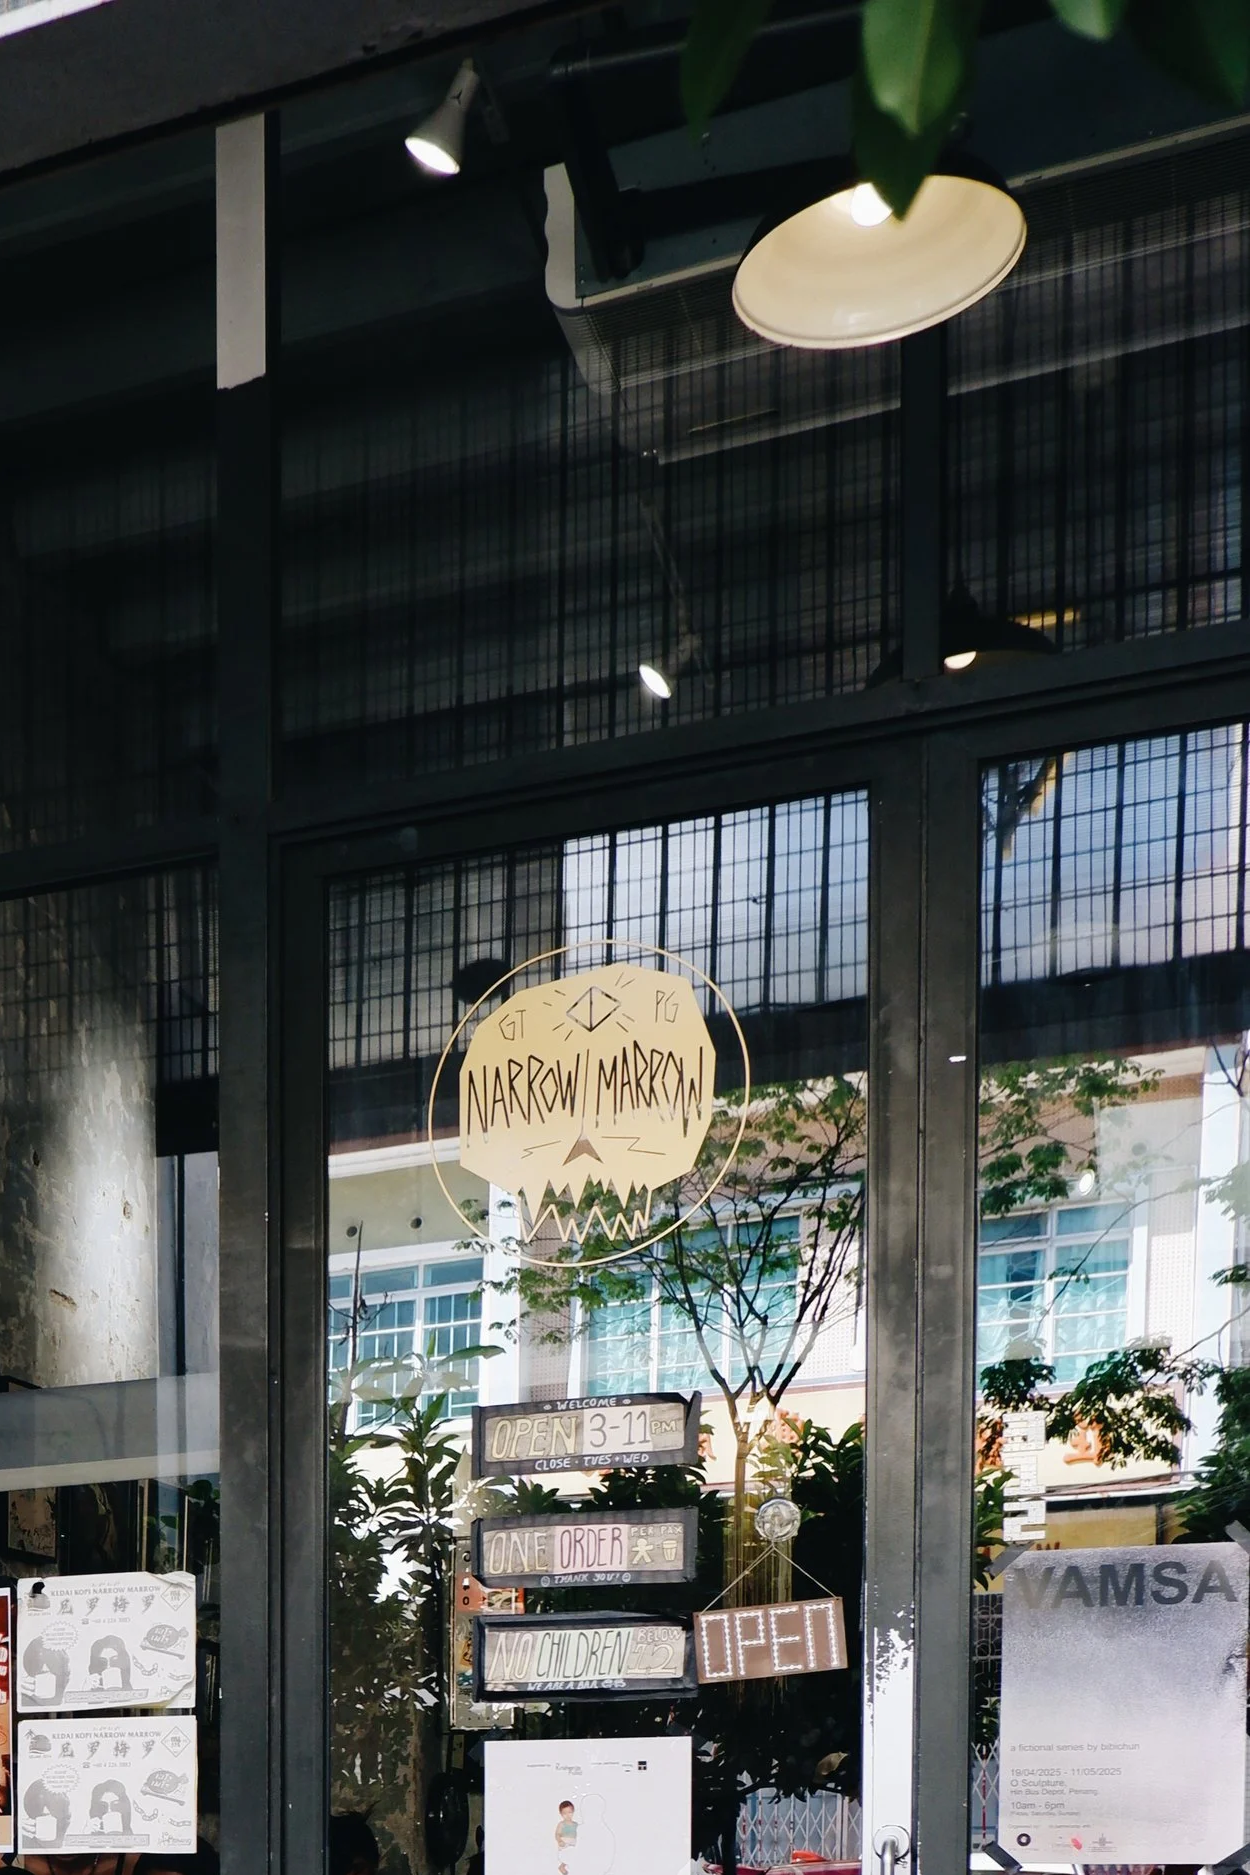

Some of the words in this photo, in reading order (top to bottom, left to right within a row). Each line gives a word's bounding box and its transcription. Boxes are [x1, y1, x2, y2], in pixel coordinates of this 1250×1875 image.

[655, 989, 680, 1024] PG
[498, 1010, 526, 1041] GT
[466, 1053, 580, 1142] NARROW
[596, 1040, 704, 1138] MARROW
[557, 1397, 617, 1410] WELCOME
[490, 1415, 578, 1459] OPEN
[589, 1411, 651, 1448] 3-11
[651, 1420, 677, 1435] PM
[534, 1457, 571, 1471] CLOSE
[583, 1454, 612, 1466] TUES
[623, 1453, 650, 1464] WED
[489, 1531, 549, 1575] ONE
[560, 1527, 623, 1569] ORDER
[631, 1526, 654, 1536] PER
[660, 1525, 683, 1535] PAX
[553, 1574, 589, 1584] THANK
[593, 1573, 620, 1582] YOU!
[1013, 1559, 1239, 1609] VAMSA
[127, 1585, 161, 1593] MARROW
[636, 1628, 682, 1642] BELOW
[699, 1600, 841, 1679] OPEN
[488, 1632, 533, 1681] NO
[536, 1630, 631, 1679] CHILDREN
[626, 1643, 677, 1675] 12
[527, 1680, 543, 1690] WE
[93, 1731, 126, 1739] NARROW
[128, 1730, 162, 1738] MARROW
[1018, 1743, 1054, 1752] fictional
[1056, 1743, 1085, 1752] series
[1087, 1743, 1098, 1753] by
[1071, 1767, 1122, 1776] 11/05/2025
[1025, 1788, 1040, 1796] Bus
[1011, 1801, 1036, 1810] 10am
